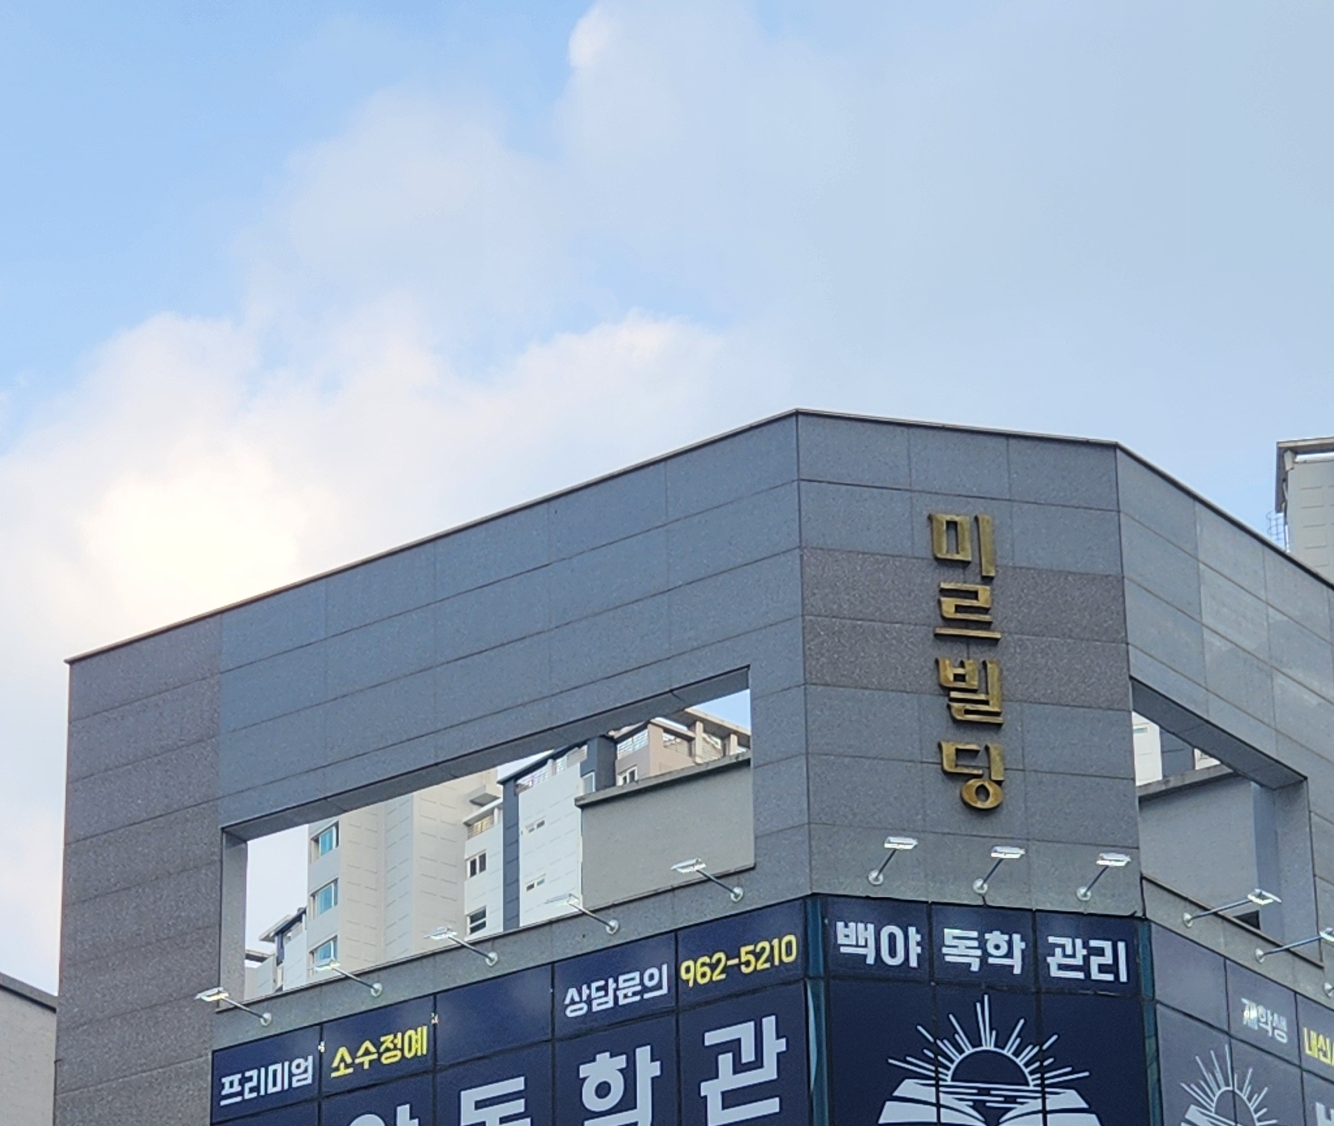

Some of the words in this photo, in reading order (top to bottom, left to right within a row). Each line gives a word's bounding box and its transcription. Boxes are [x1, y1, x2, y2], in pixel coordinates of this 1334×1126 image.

[927, 513, 1005, 810] 미르빌딩
[564, 963, 669, 1018] 상담문의
[679, 934, 798, 988] 962-5210
[835, 920, 922, 968] 백야
[942, 928, 1026, 975] 독학
[1047, 935, 1128, 982] 관리
[219, 1055, 314, 1107] 프리미엄
[330, 1026, 428, 1078] 소수정예
